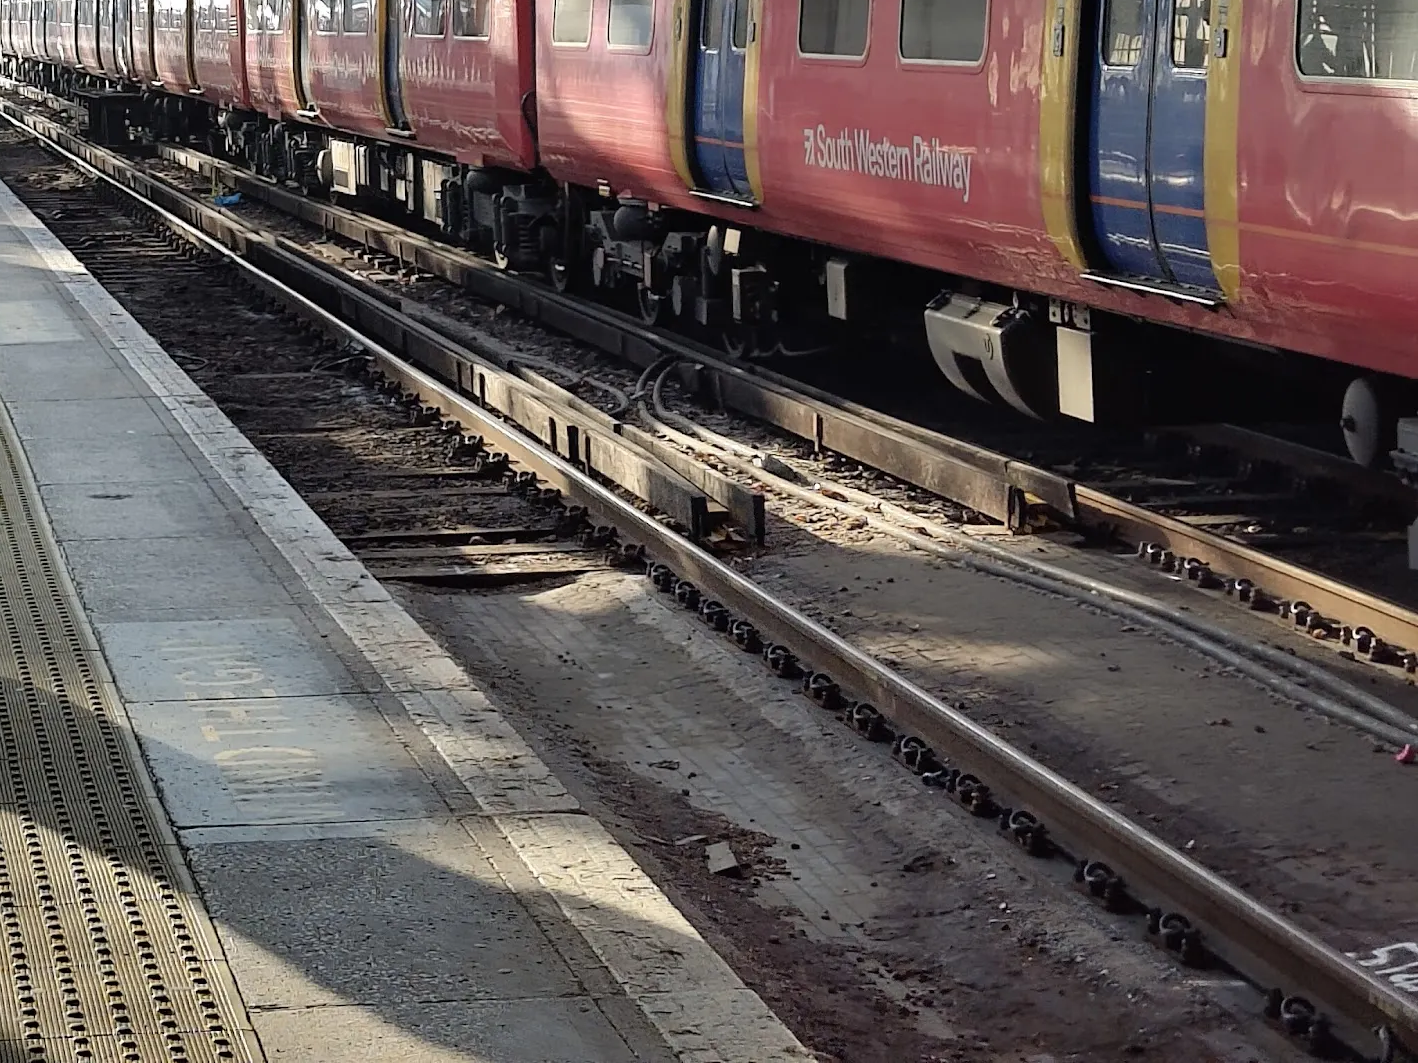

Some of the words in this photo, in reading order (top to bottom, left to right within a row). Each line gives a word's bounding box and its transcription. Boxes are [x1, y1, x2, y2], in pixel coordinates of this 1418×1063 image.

[817, 123, 854, 172] South
[854, 128, 912, 181] Western
[913, 135, 972, 204] Railway
